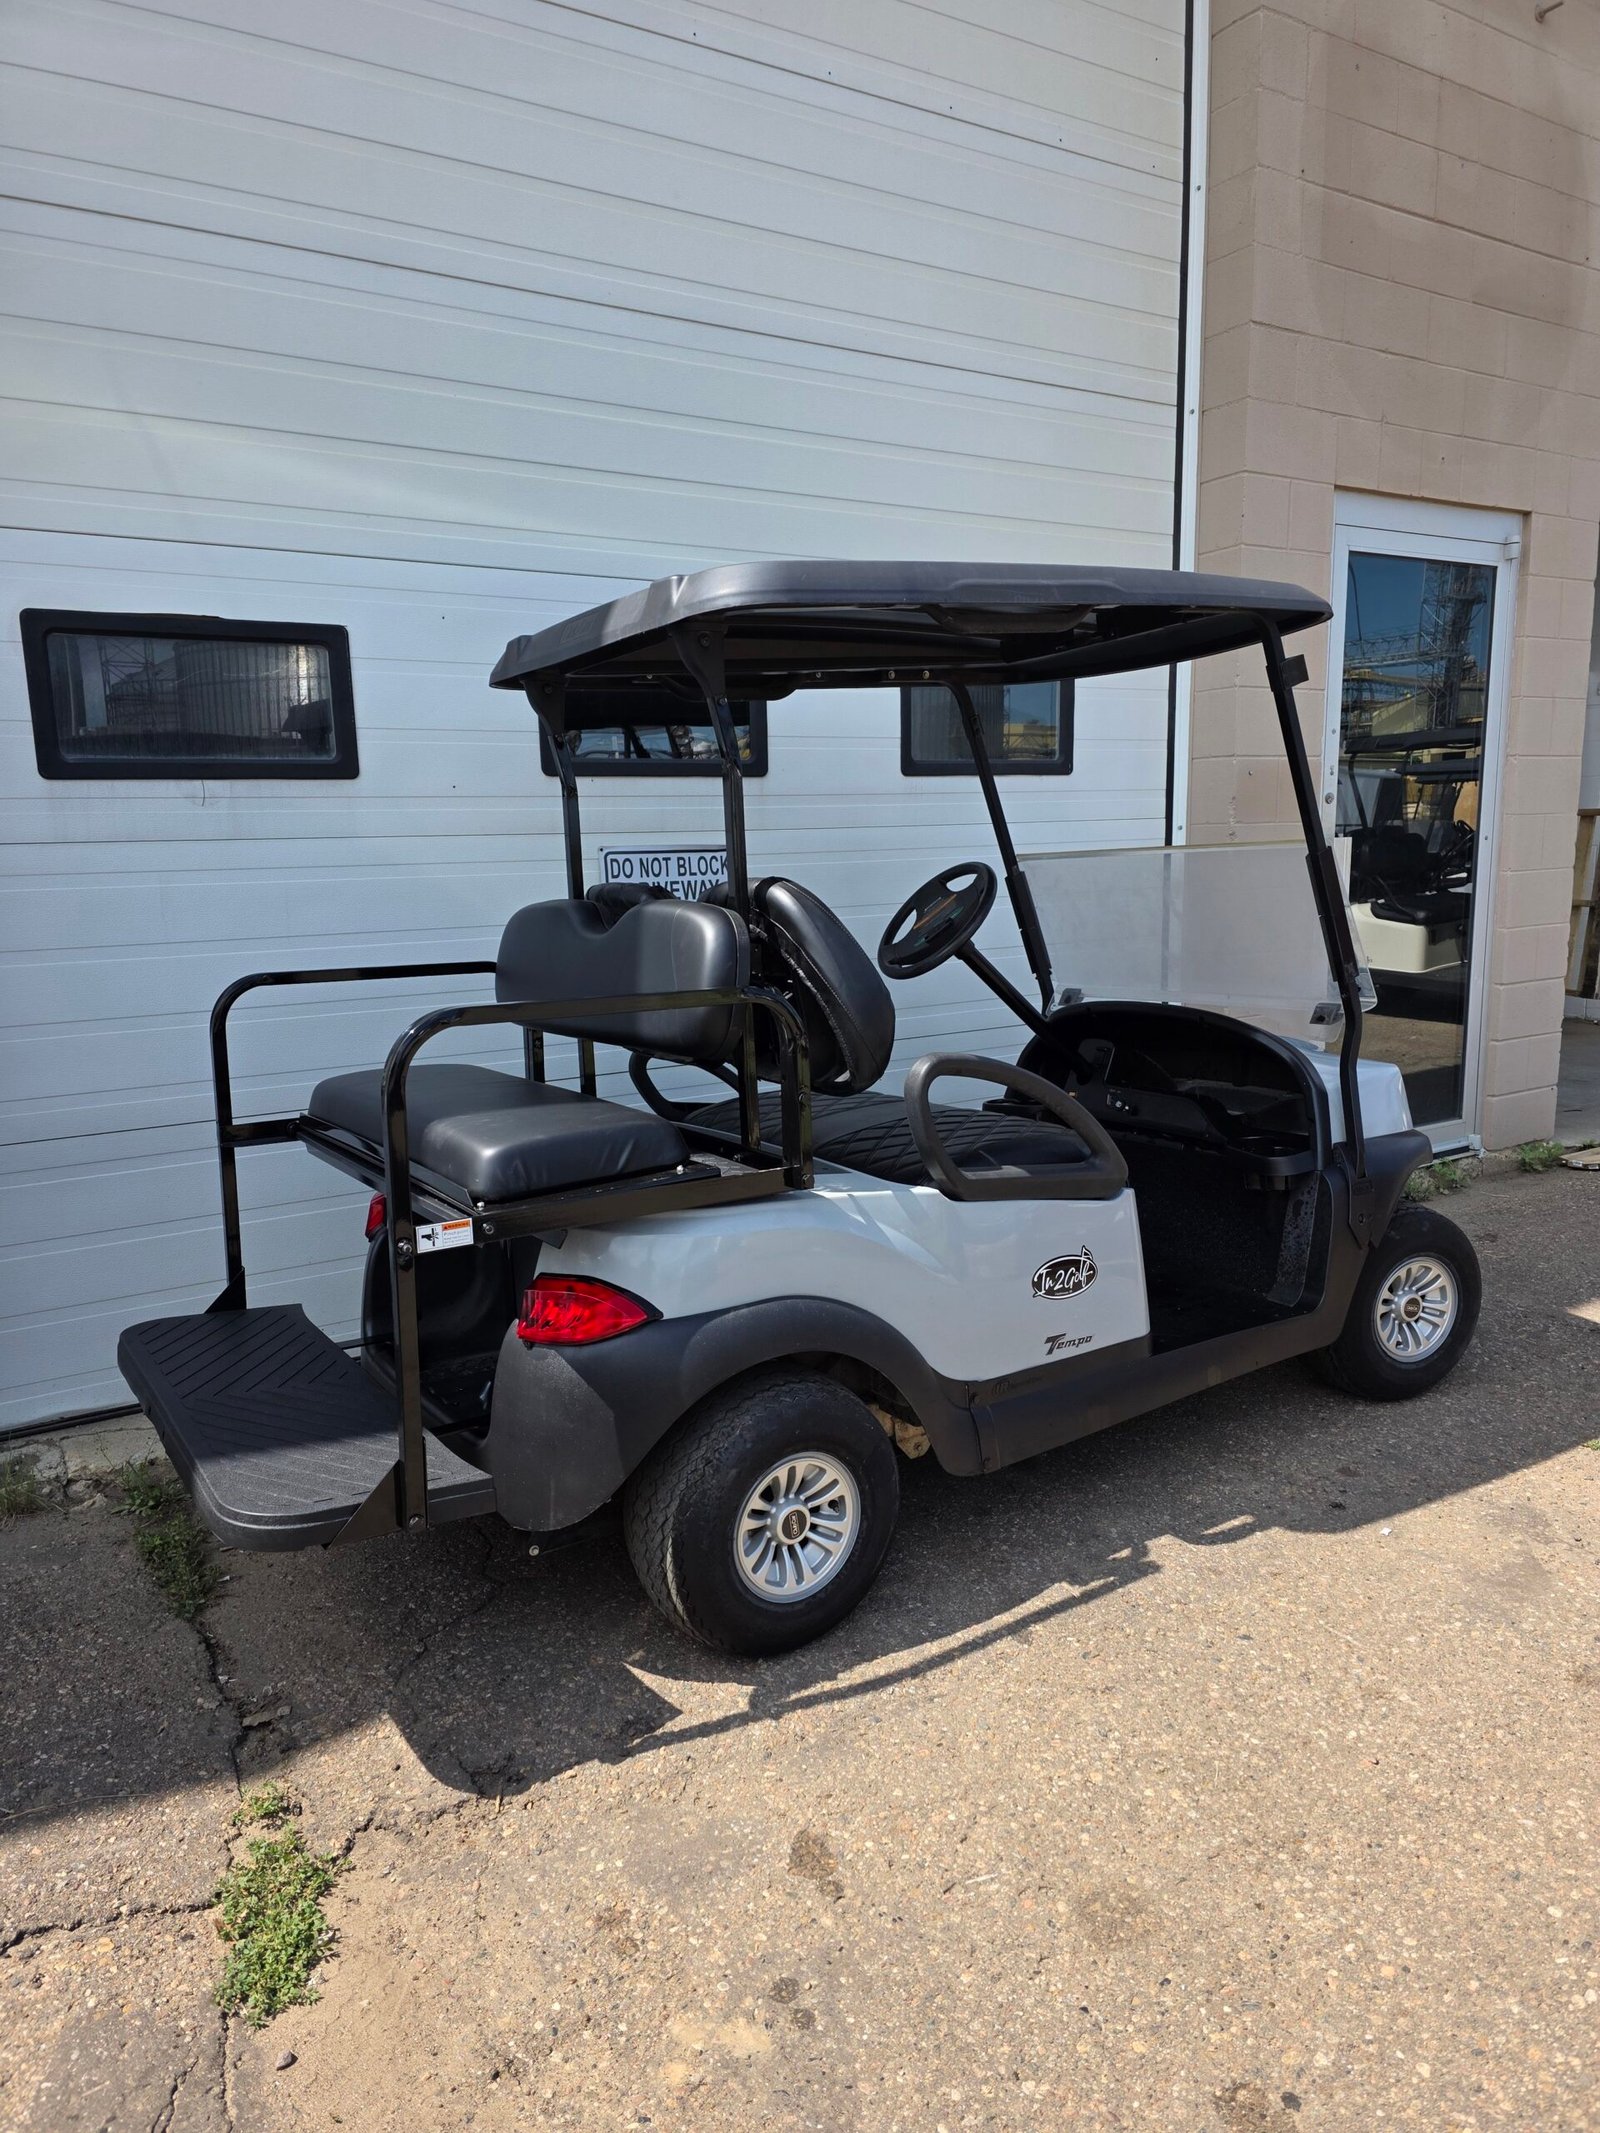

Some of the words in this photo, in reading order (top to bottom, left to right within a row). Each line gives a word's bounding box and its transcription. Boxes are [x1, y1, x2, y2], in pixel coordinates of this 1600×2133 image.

[610, 857, 634, 879] DO
[639, 856, 672, 878] NOT
[677, 855, 728, 877] BLOCK
[1040, 1260, 1094, 1294] In2Golf
[1044, 1333, 1093, 1356] Tempo
